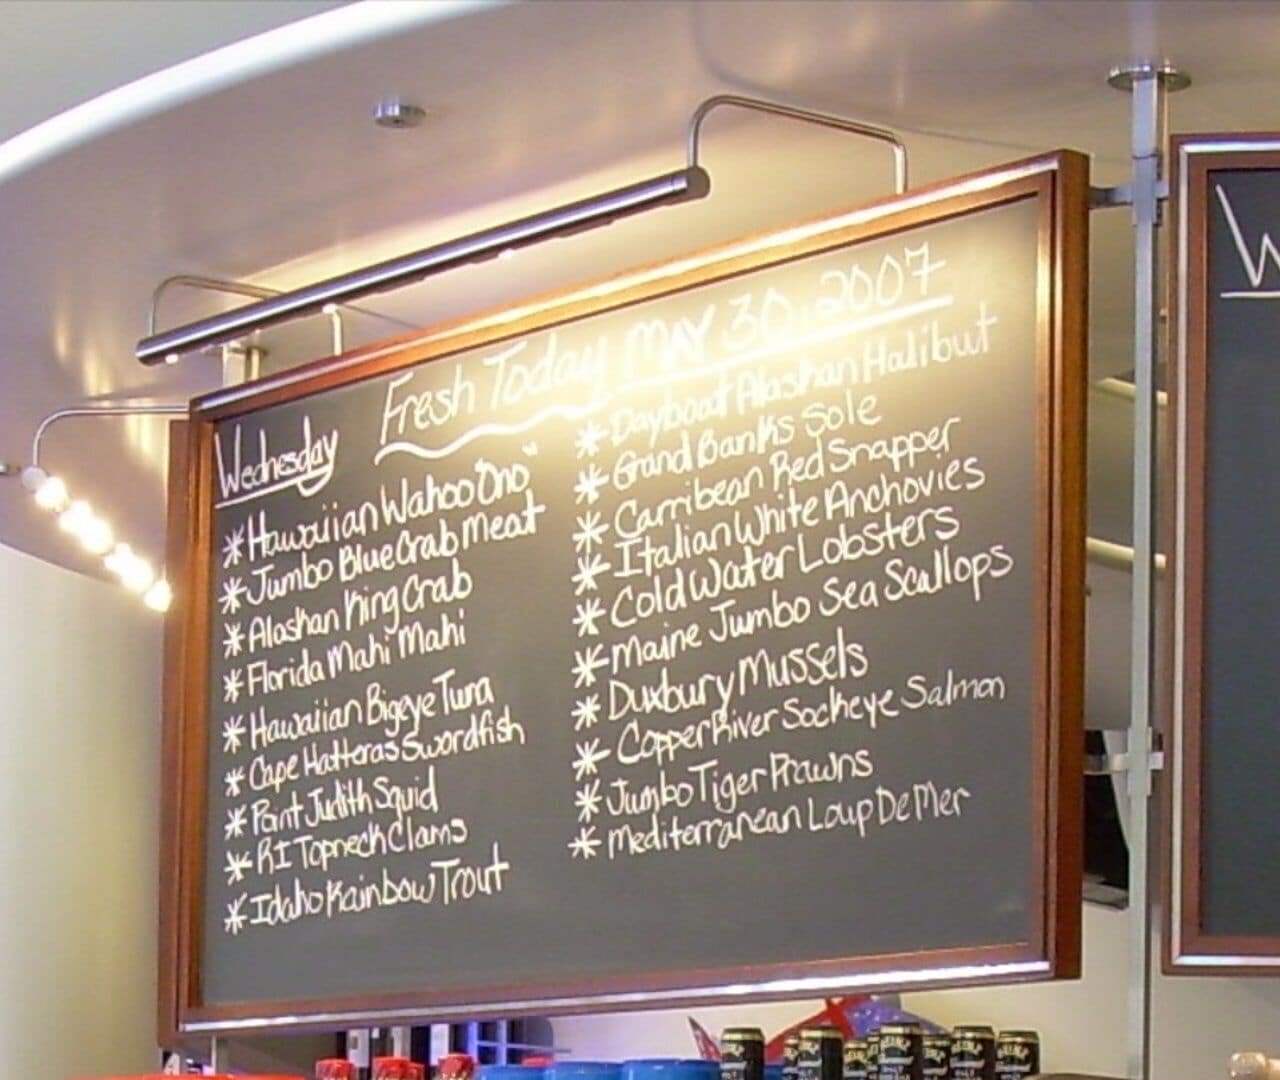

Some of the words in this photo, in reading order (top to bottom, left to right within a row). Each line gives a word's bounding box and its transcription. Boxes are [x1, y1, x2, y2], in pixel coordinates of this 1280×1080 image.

[378, 361, 476, 446] Fresh
[482, 331, 608, 413] Today
[819, 241, 948, 312] 2007
[862, 301, 999, 384] Halibut
[214, 415, 338, 498] Wednesday
[612, 429, 694, 491] Grand
[697, 414, 796, 469] Banks
[801, 388, 882, 438] Sole
[613, 466, 764, 541] Carribean
[768, 434, 825, 492] Red
[827, 415, 962, 474] Snapper
[248, 503, 380, 563] Hawaiian
[380, 472, 475, 527] Wahoo
[613, 519, 732, 579] Italian
[733, 492, 820, 549] White
[823, 452, 987, 522] Anchovies
[246, 552, 334, 606] Jumbo
[339, 539, 394, 584] Blue
[395, 519, 458, 568] Crab
[609, 567, 687, 629] Cold
[688, 544, 796, 600] Water
[797, 505, 961, 575] Lobsters
[247, 647, 324, 697] Florida
[327, 632, 391, 679] Mahi
[398, 608, 466, 659] Mahi
[248, 605, 340, 653] Alaskan
[344, 585, 400, 635] King
[402, 567, 473, 612] Crab
[610, 622, 703, 675] Maine
[708, 589, 812, 643] Jumbo
[819, 575, 880, 618] Sea
[884, 542, 1015, 602] Scallops
[249, 698, 363, 750] Hawaiian
[367, 682, 436, 738] Bigeye
[431, 668, 495, 716] Tuna
[607, 666, 736, 722] Duxbury
[738, 626, 871, 694] Mussels
[617, 718, 715, 767] Copper
[710, 701, 780, 748] River
[781, 685, 901, 730] Sockeye
[900, 668, 1006, 710] Salmon
[248, 755, 300, 793] Cape
[303, 737, 401, 777] Hatteras
[401, 704, 526, 763] Swordfish
[605, 768, 695, 817] Jumbo
[687, 758, 768, 813] Tiger
[768, 747, 875, 793] Prawns
[305, 777, 374, 828] Judith
[373, 765, 439, 822] Squid
[607, 802, 802, 860] Mediterranean
[807, 796, 875, 839] Loup
[875, 785, 910, 826] De
[913, 779, 973, 823] Mer
[248, 883, 324, 927] Idaho
[430, 841, 511, 906] Trout
[257, 837, 293, 876] RI
[387, 817, 469, 853] Clams
